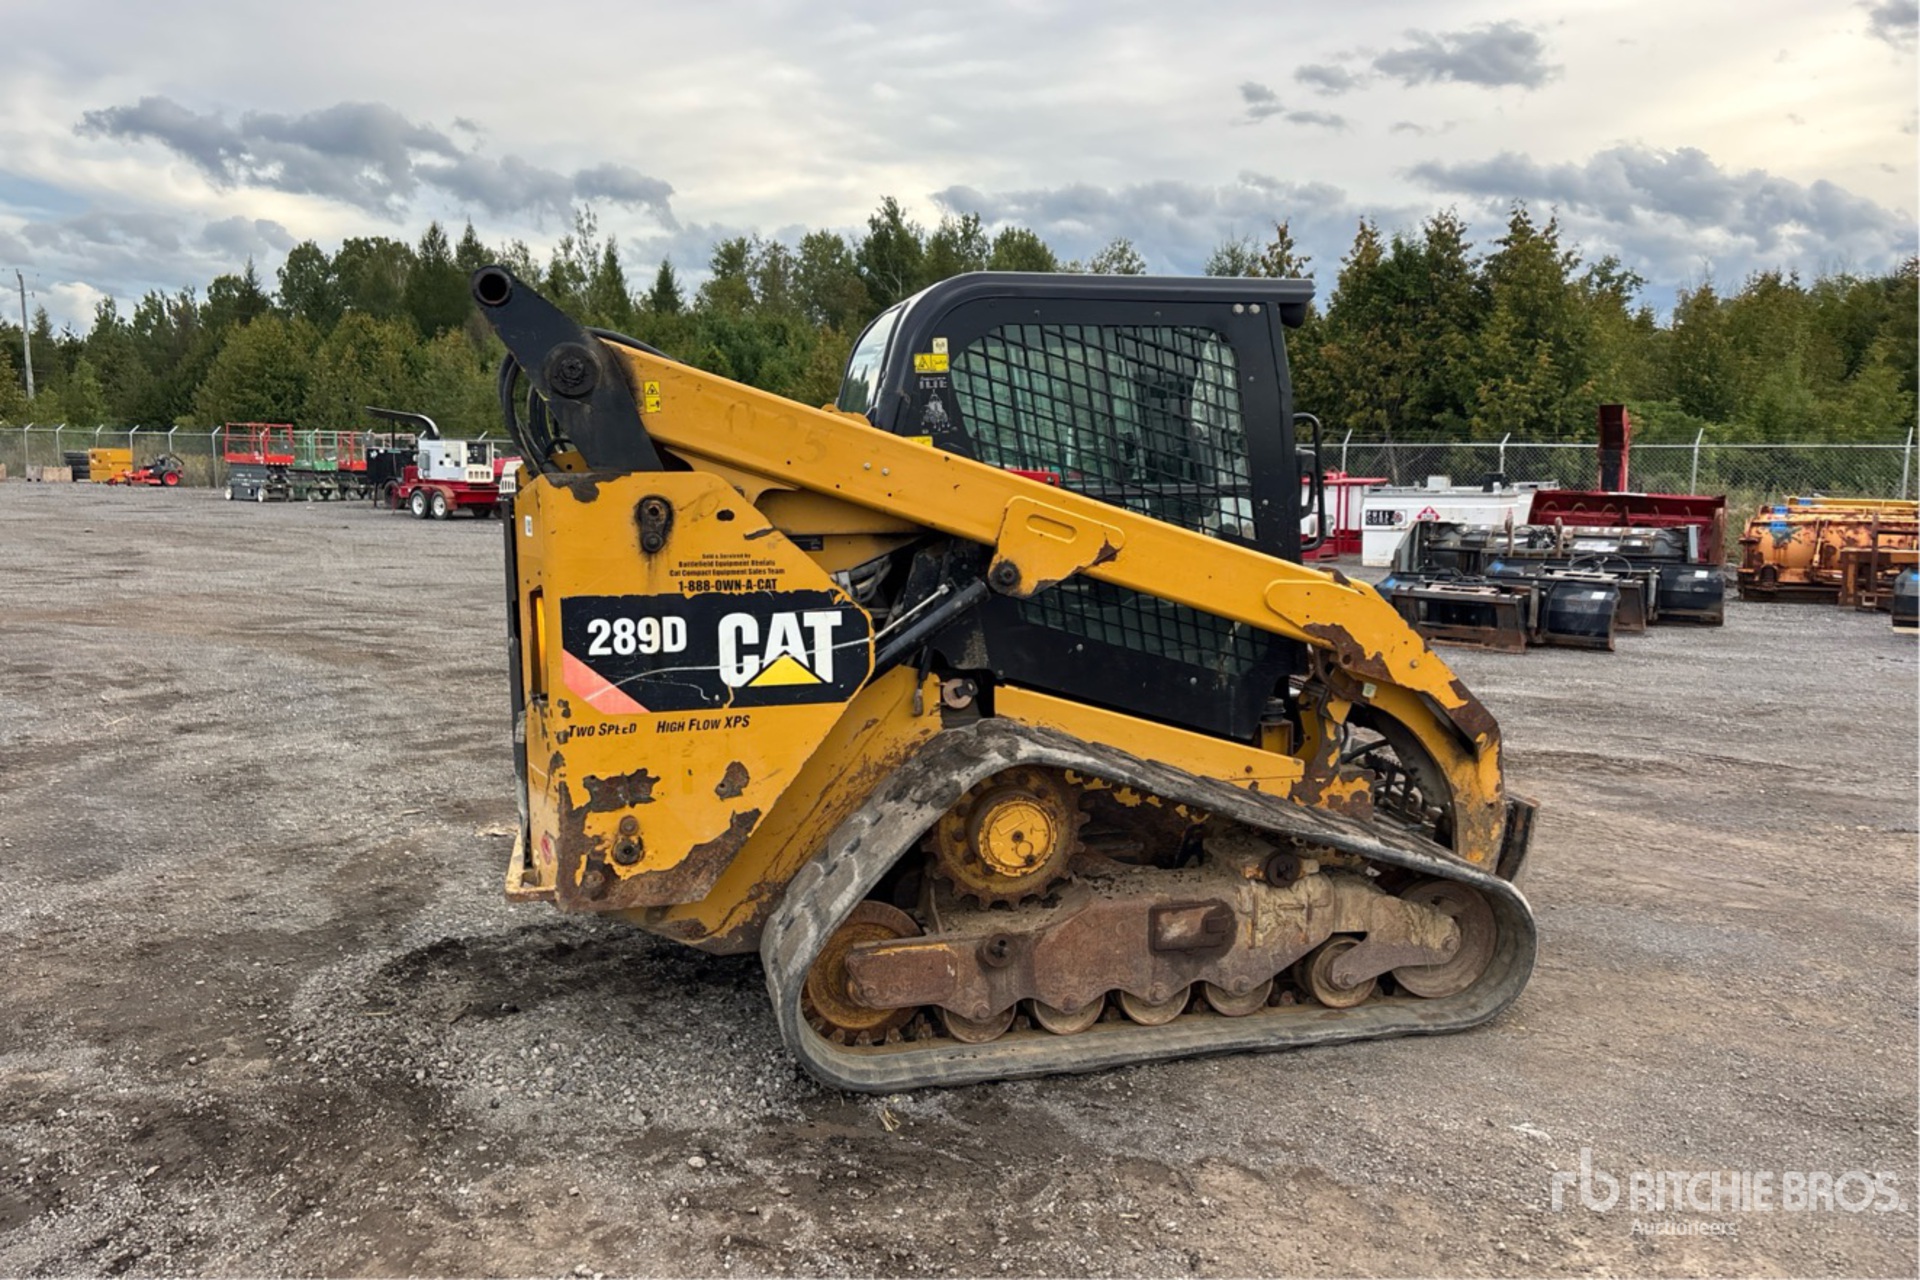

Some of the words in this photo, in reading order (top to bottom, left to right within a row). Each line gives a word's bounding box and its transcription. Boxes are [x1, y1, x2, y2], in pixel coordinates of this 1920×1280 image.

[715, 560, 750, 568] Equipment
[682, 569, 711, 577] Compact
[712, 569, 747, 577] Equipment
[678, 578, 778, 592] 1-888-OWN-A-CAT
[587, 616, 687, 656] 289D
[718, 610, 842, 688] CAT
[724, 714, 750, 729] XPS
